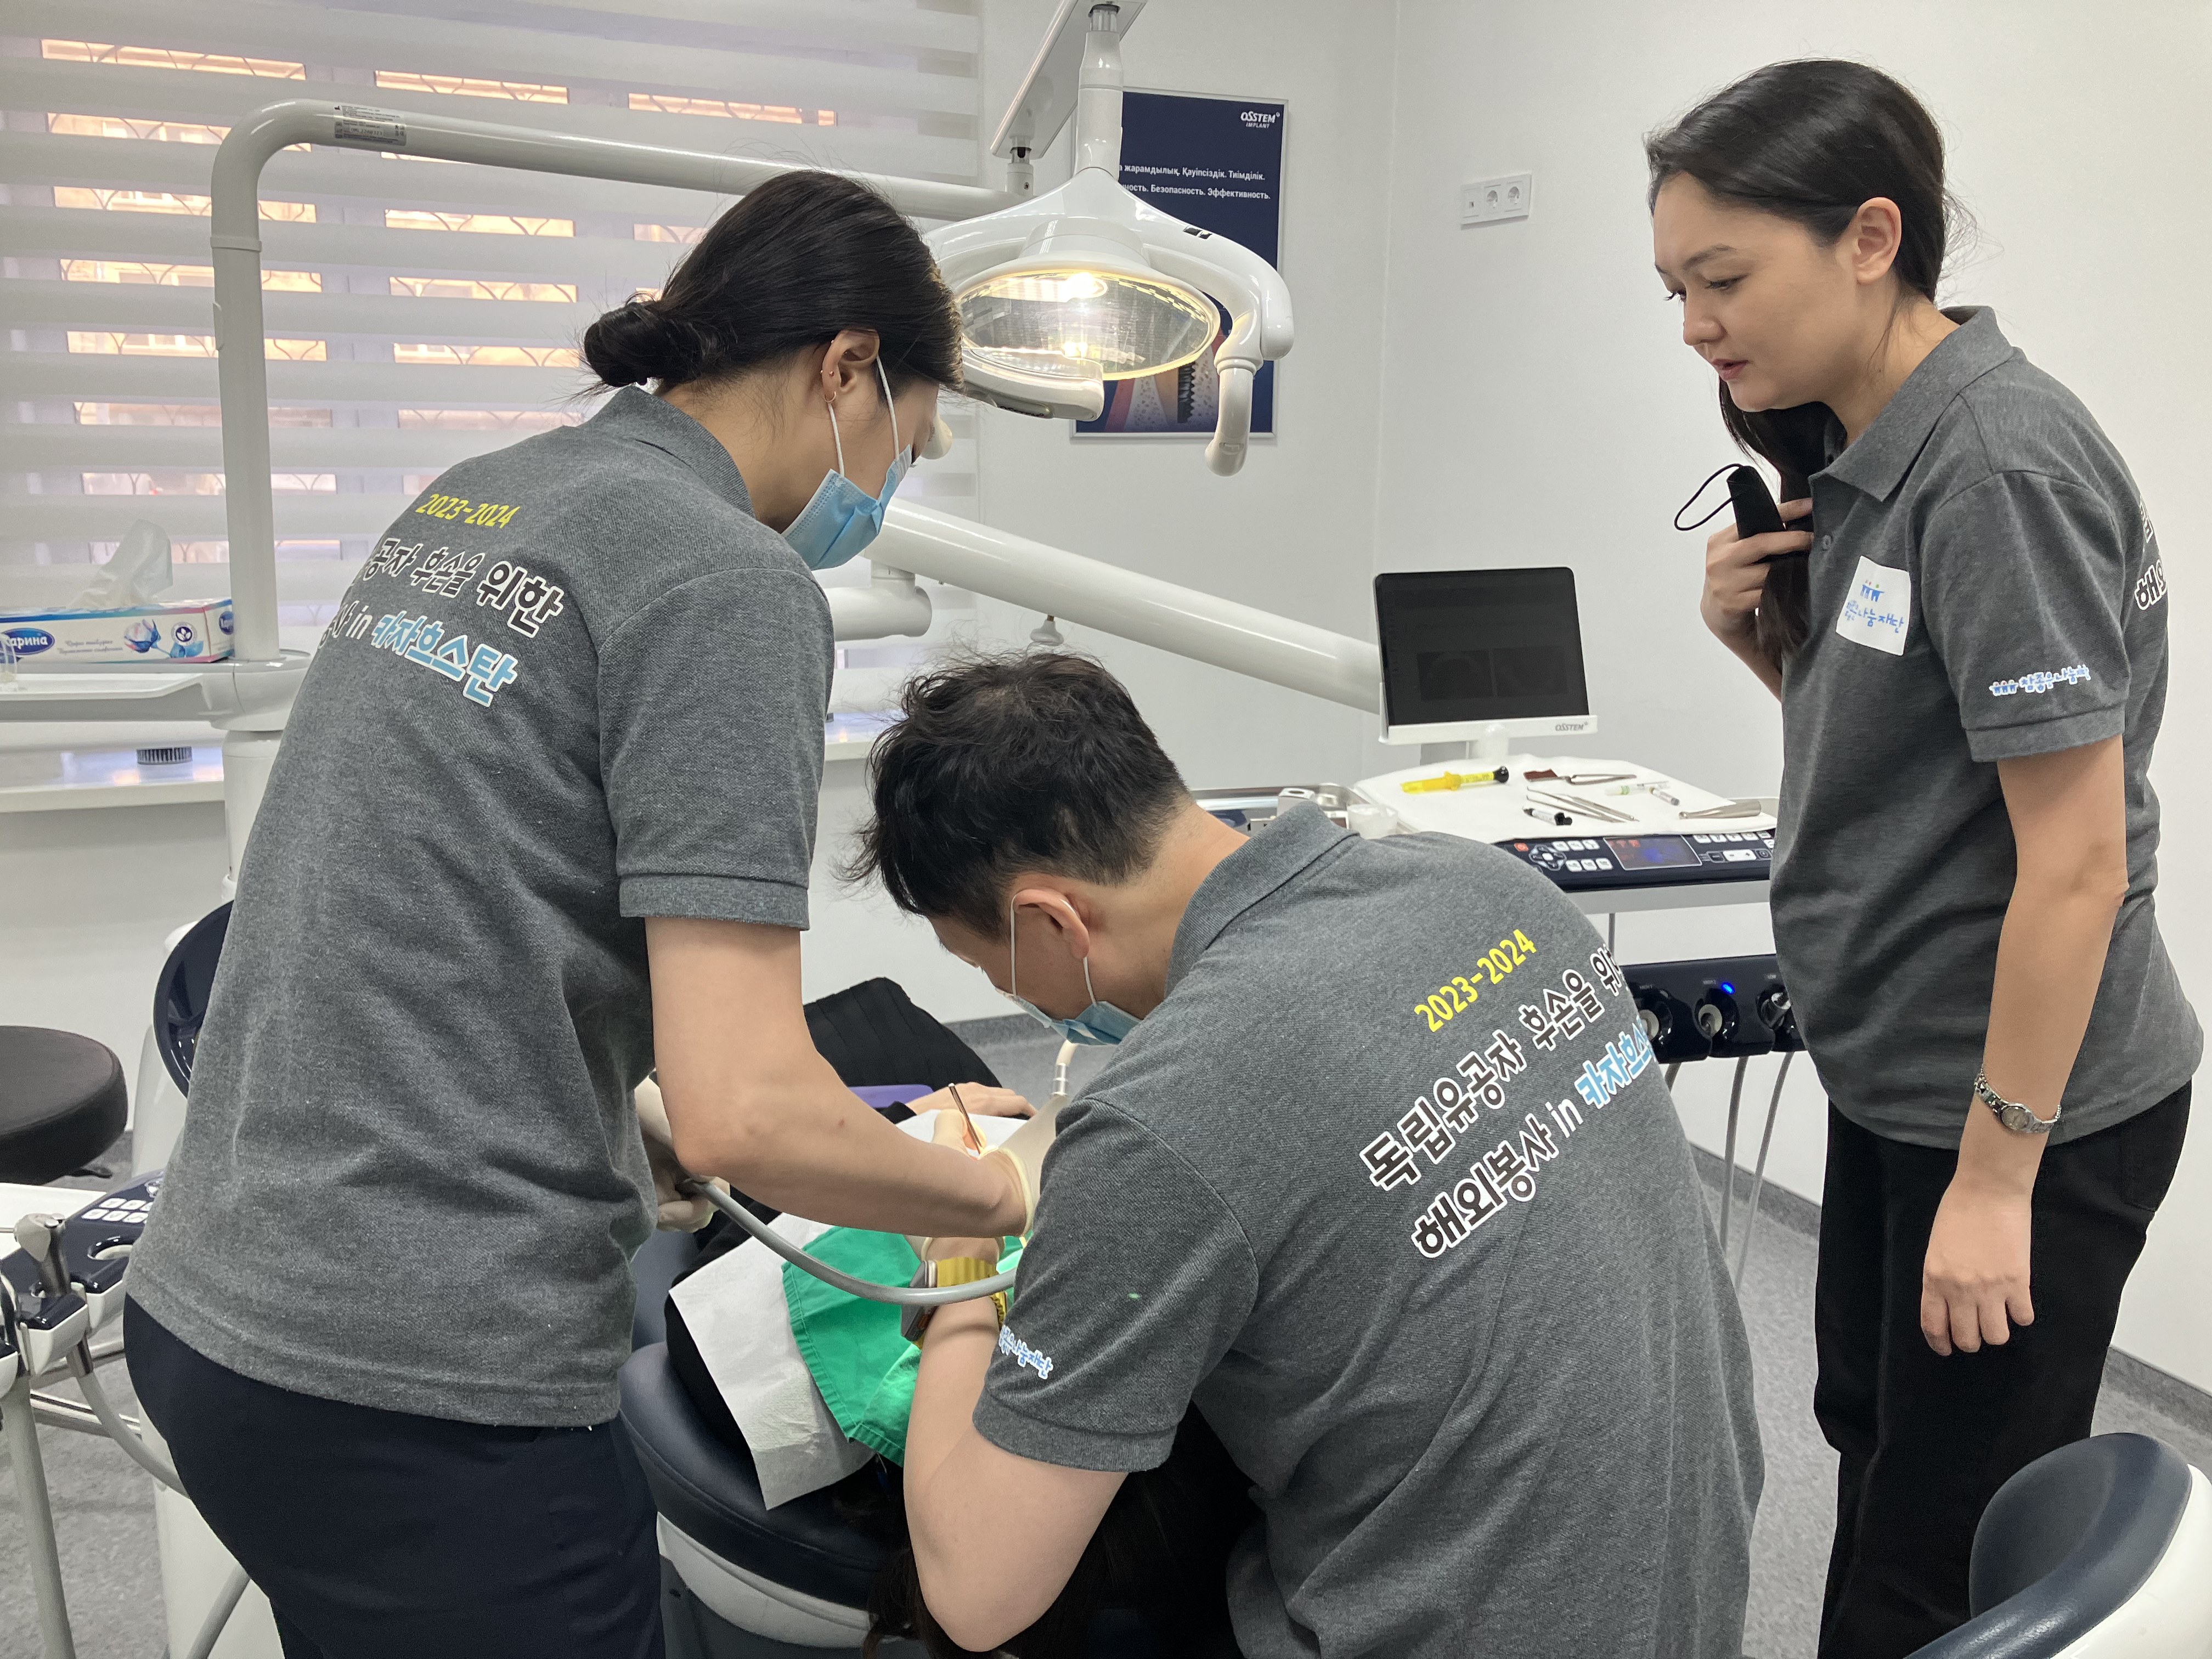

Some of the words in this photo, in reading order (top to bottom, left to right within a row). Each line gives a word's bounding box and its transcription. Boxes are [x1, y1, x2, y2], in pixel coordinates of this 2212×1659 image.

[1240, 111, 1276, 123] OSSTEM
[1150, 184, 1206, 195] Безопасность.
[1207, 188, 1271, 199] Эффективность.
[1182, 167, 1227, 179] Қауіпсіздік.
[1228, 170, 1265, 180] Тиімділік.
[415, 494, 521, 528] 2023-2024
[361, 537, 424, 582] 공자
[410, 546, 486, 598] 후손을
[476, 560, 565, 639] 위한
[4, 636, 48, 650] арина
[345, 605, 373, 640] in
[370, 610, 518, 708] 카자흐스탄
[1414, 929, 1537, 1032] 2023-2024
[1359, 1029, 1527, 1191] 독립유공자
[1519, 969, 1605, 1051] 후손을
[1590, 944, 1629, 997] 위
[1411, 1114, 1559, 1258] 해외봉사
[1545, 1098, 1583, 1138] in
[1575, 1015, 1657, 1109] 카자흐스
